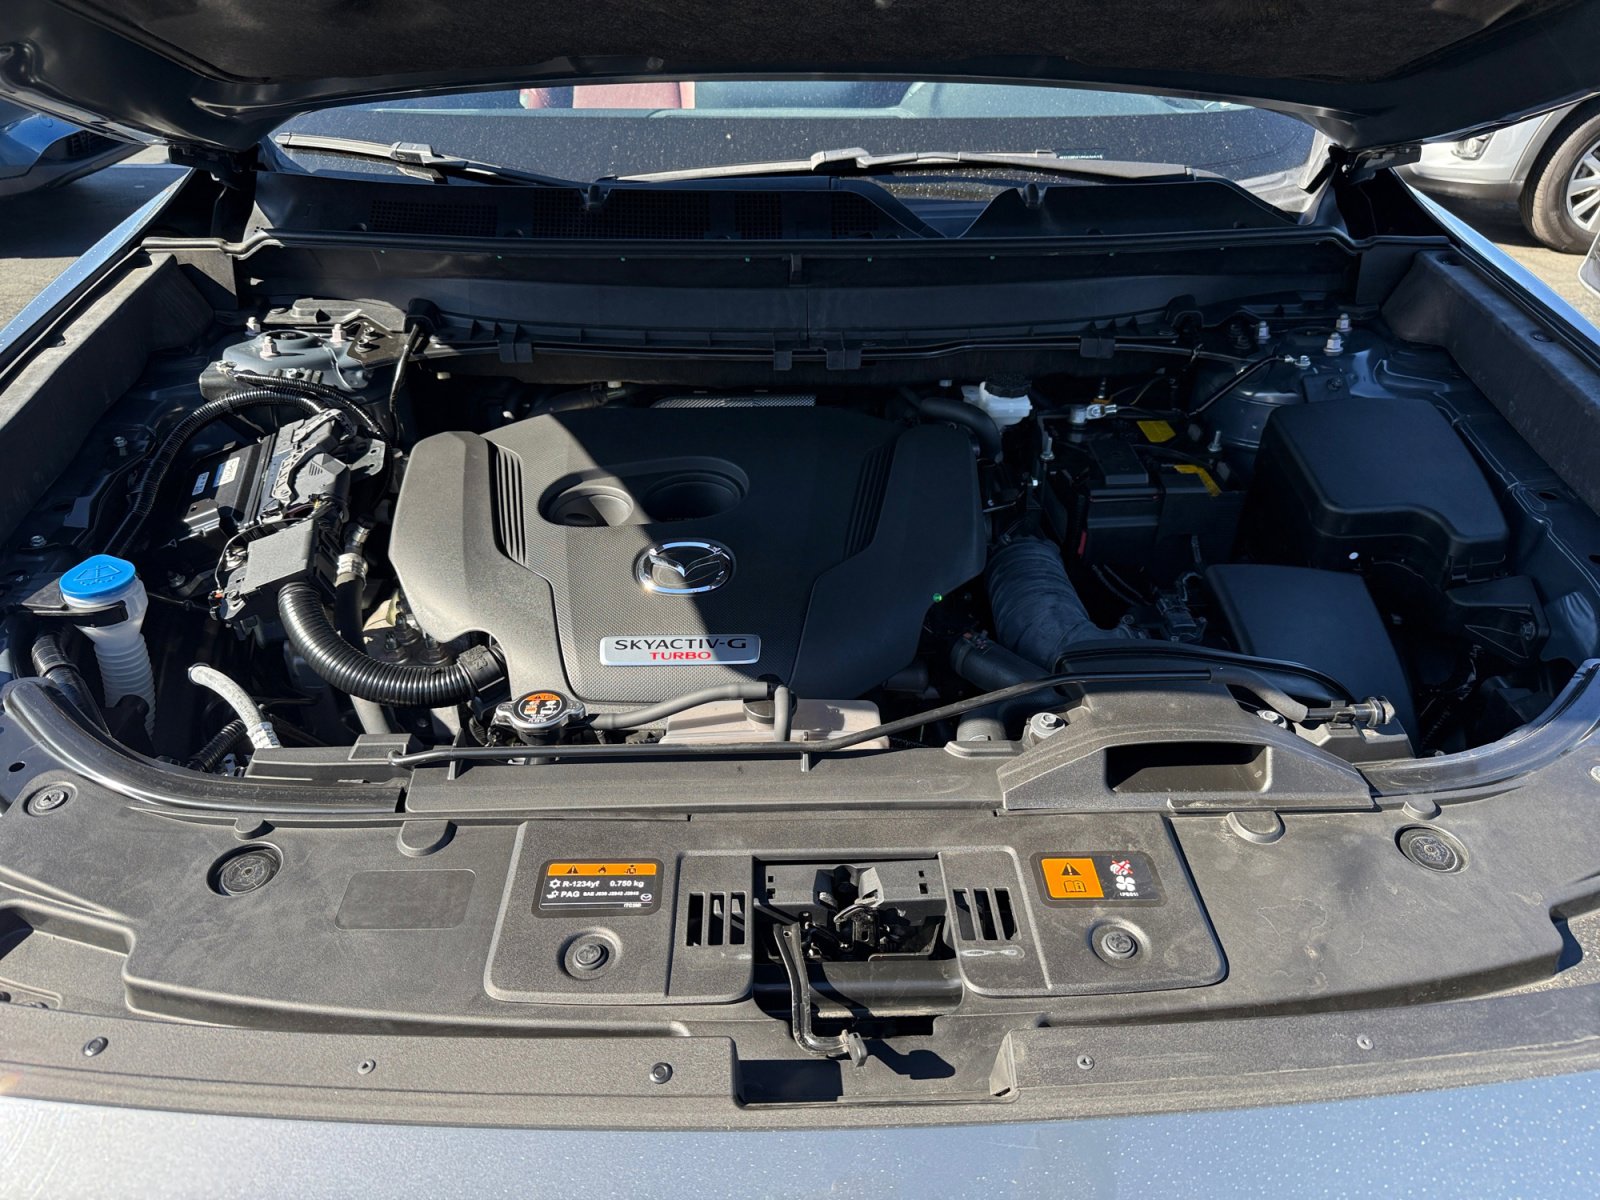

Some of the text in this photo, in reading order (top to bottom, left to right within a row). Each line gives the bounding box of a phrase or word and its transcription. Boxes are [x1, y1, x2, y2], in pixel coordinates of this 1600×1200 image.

[614, 638, 747, 650] SKYACTIV-G
[649, 651, 712, 660] TURBO
[562, 880, 600, 888] R-1234yf
[633, 880, 645, 888] kg
[560, 890, 580, 898] PAG
